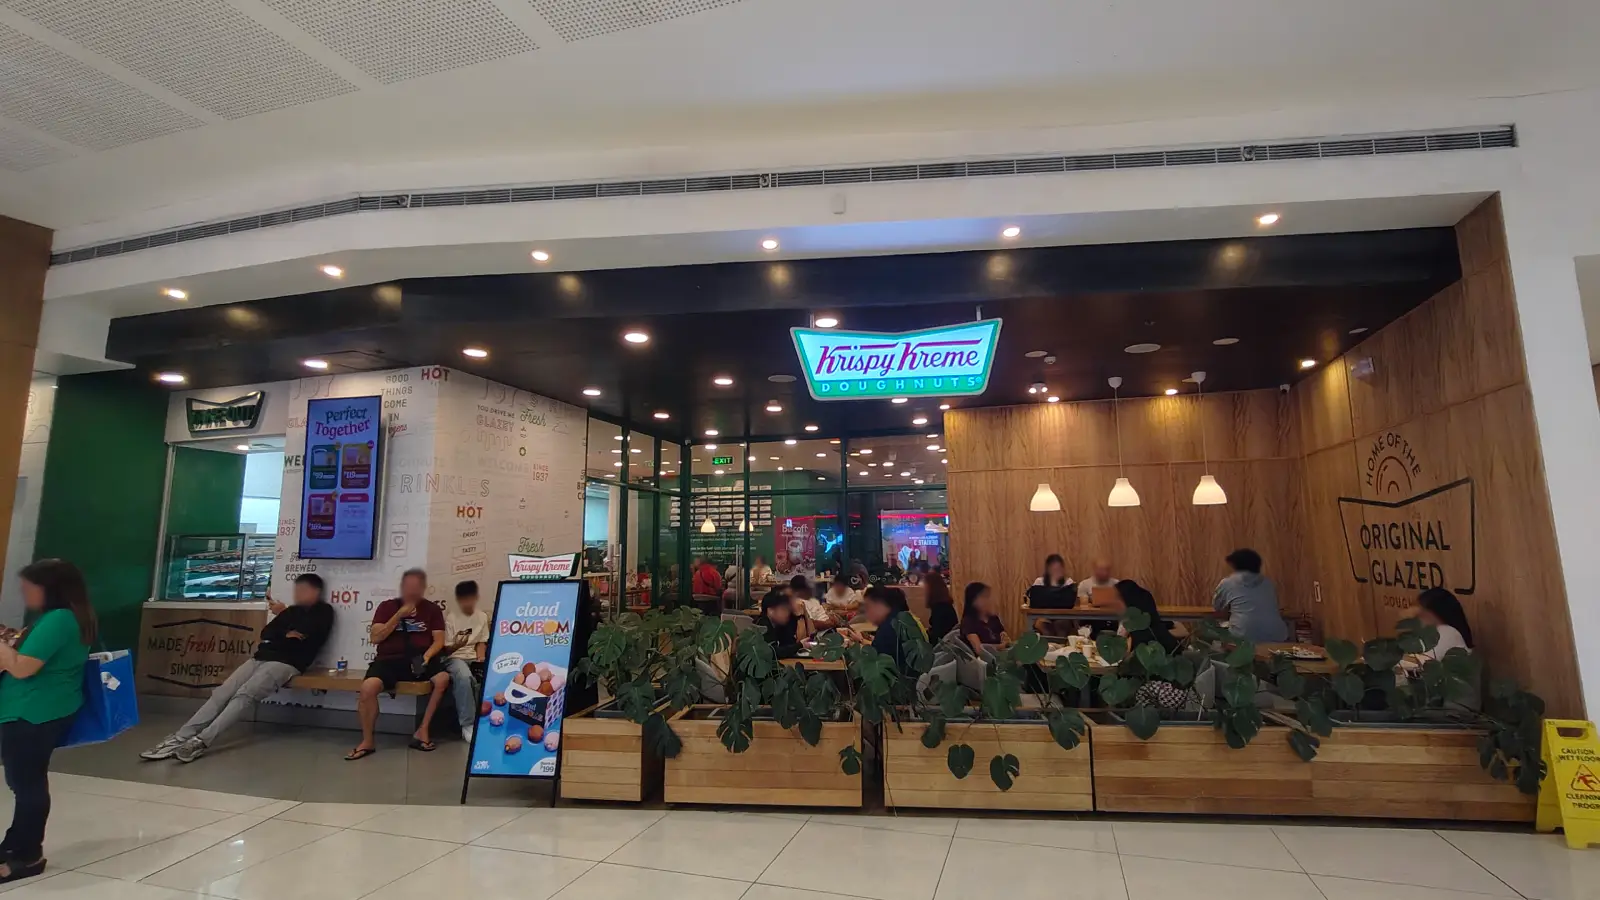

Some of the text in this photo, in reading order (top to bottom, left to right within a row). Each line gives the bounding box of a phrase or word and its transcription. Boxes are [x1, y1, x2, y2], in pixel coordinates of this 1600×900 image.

[815, 338, 982, 376] Krispy Kreme
[386, 374, 409, 383] GOOD
[421, 367, 450, 382] HOT
[380, 386, 413, 396] THINGS
[821, 377, 976, 392] DOUGHNUTS
[384, 399, 407, 409] COME
[477, 404, 489, 412] YOU
[490, 408, 506, 417] DRIVE
[325, 405, 367, 422] Perfect
[388, 412, 400, 421] IN
[520, 408, 546, 426] Fresh
[315, 418, 370, 440] Together
[714, 457, 731, 465] EXIT
[1366, 432, 1421, 486] HOME OF THE
[532, 471, 549, 482] 1937
[456, 505, 483, 519] HOT
[1360, 520, 1452, 551] ORIGINAL
[518, 536, 545, 553] Fresh
[285, 564, 317, 572] BREWED
[512, 559, 572, 573] Krispy Kreme
[1371, 560, 1444, 590] GLAZED
[330, 590, 360, 605] HOT
[1384, 595, 1414, 609] DOUGH
[516, 601, 560, 617] cloud
[147, 634, 255, 657] MADE fresh DAILY
[544, 634, 570, 646] bites
[170, 663, 202, 677] SINCE
[1566, 793, 1600, 801] CLEANIN
